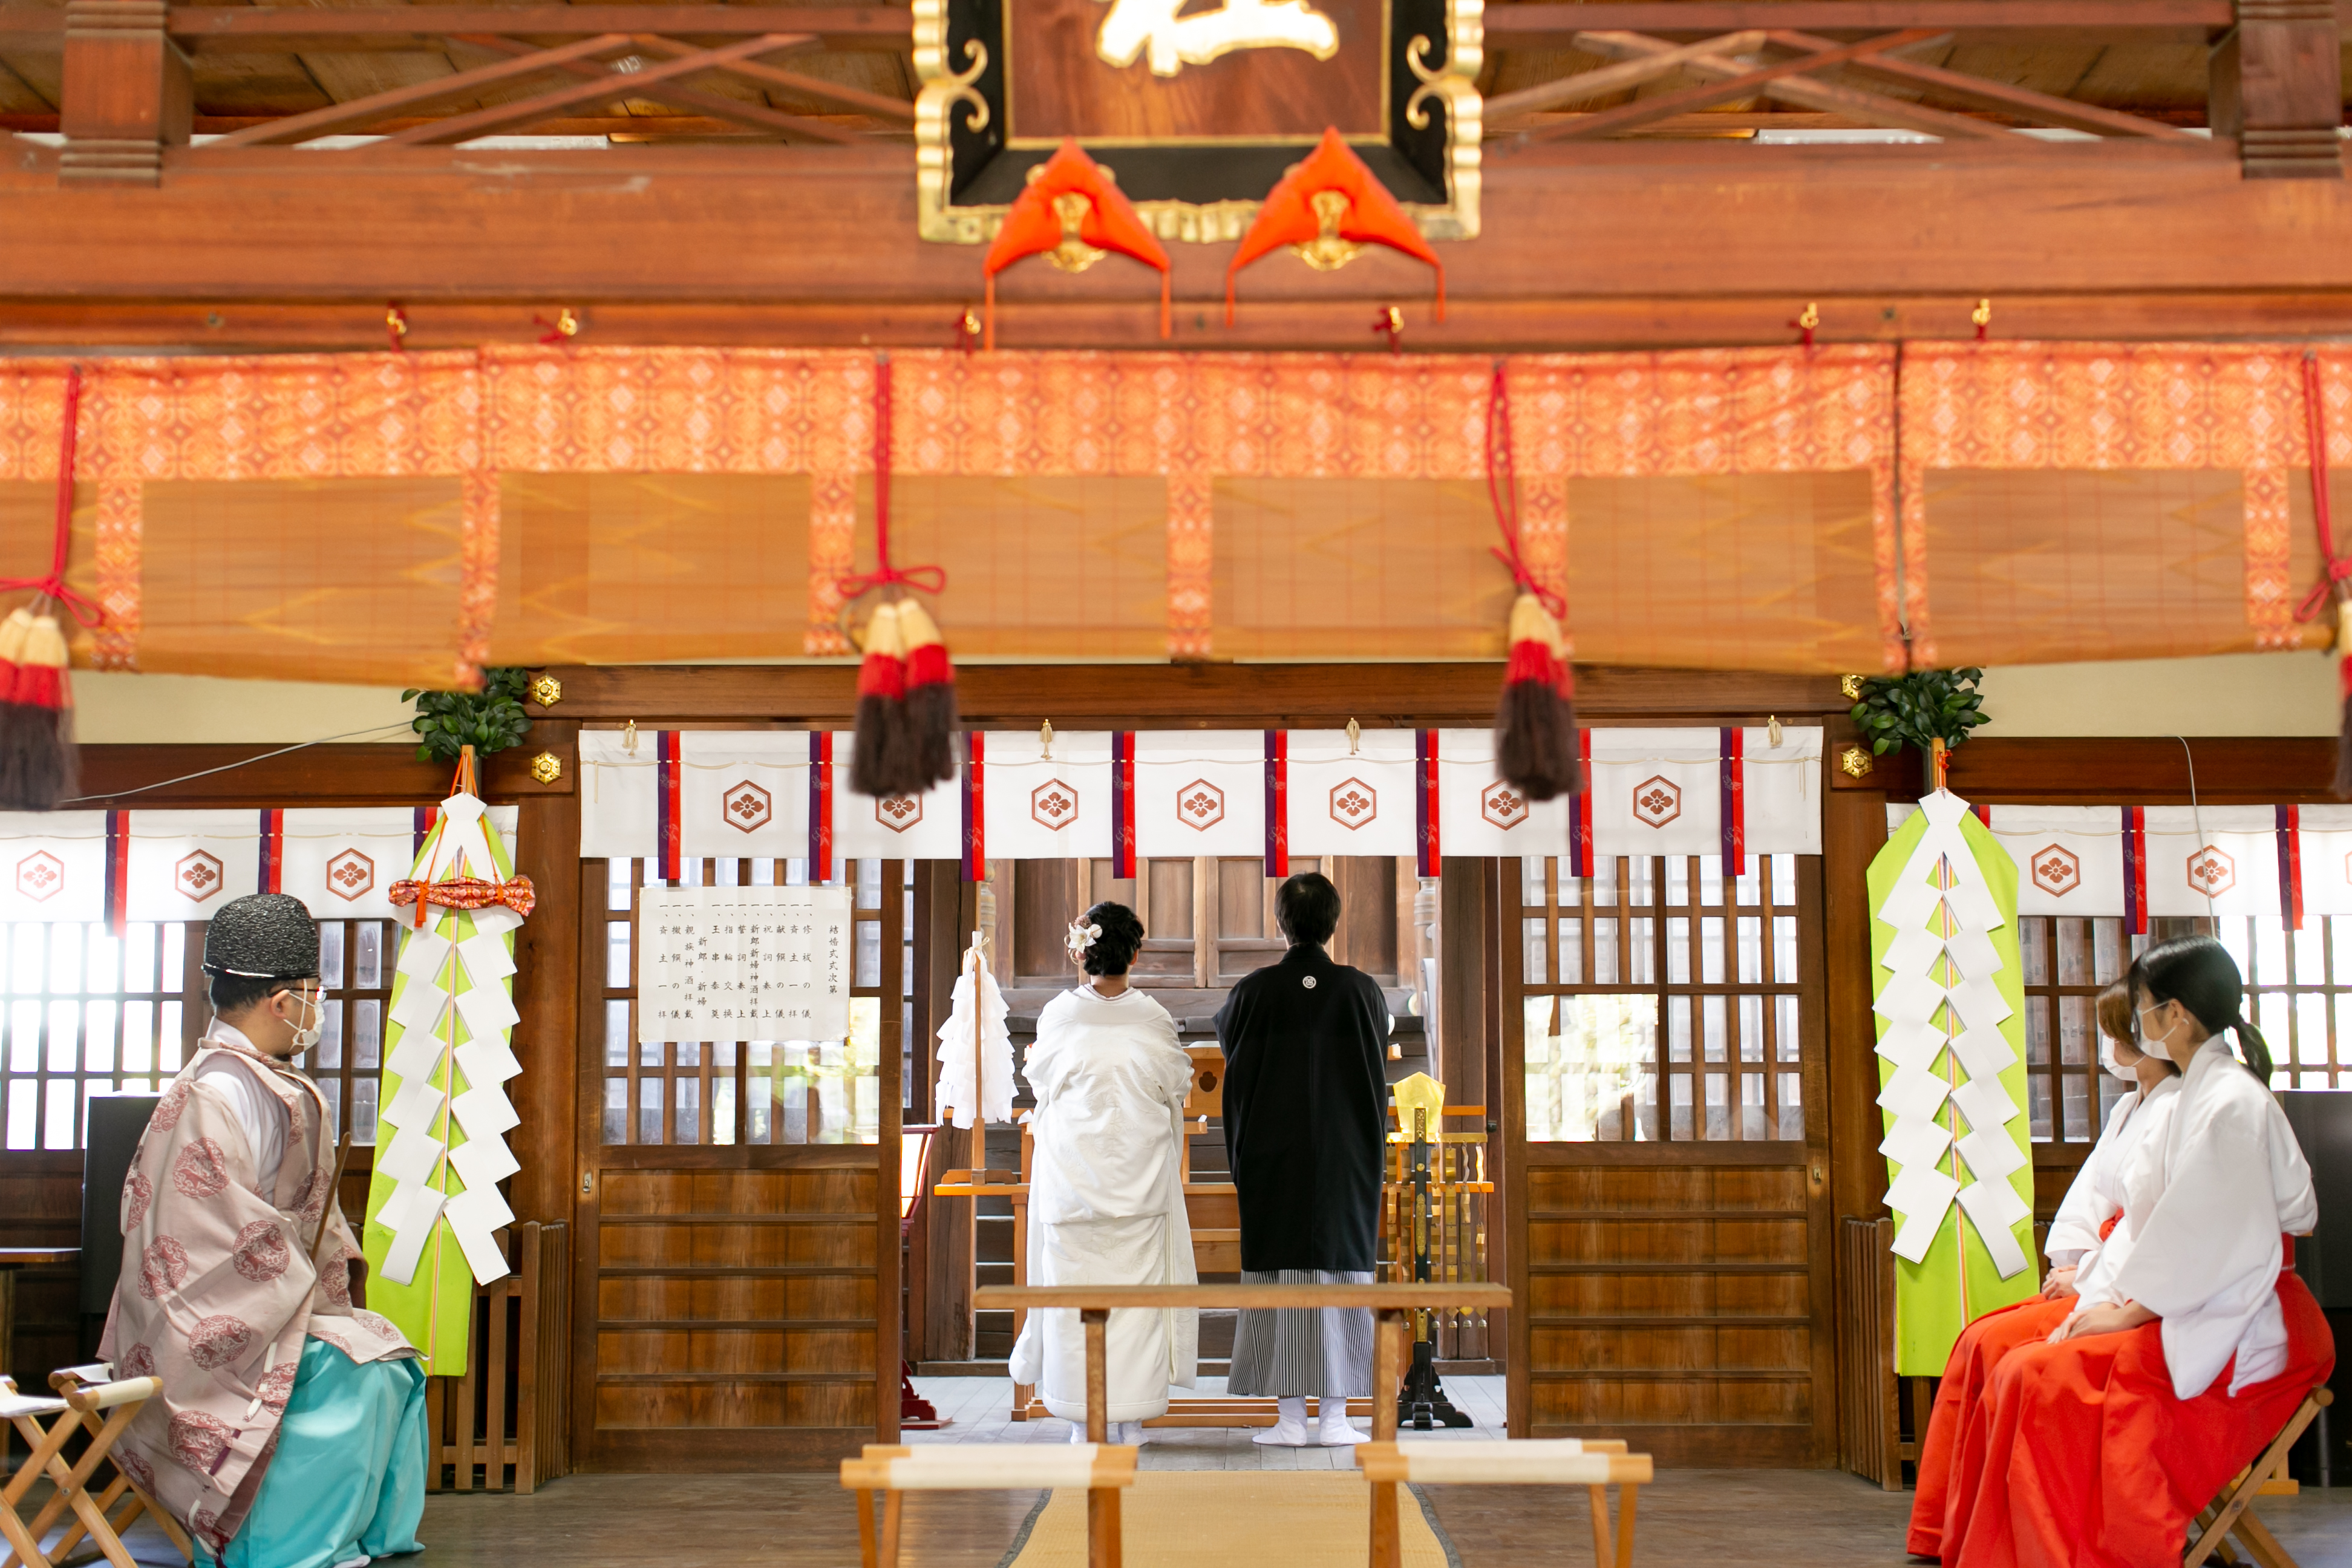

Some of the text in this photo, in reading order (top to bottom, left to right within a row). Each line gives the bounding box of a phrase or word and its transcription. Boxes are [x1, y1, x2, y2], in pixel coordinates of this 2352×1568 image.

[696, 936, 708, 1007] 新郎・新婦
[723, 904, 734, 1019] 一、指輪交換
[736, 904, 747, 1019] 一、誓詞奏上
[762, 904, 773, 1018] 一、祝詞奏上
[801, 904, 813, 1019] 一、修祓の儀
[828, 925, 839, 995] 結婚式式次第
